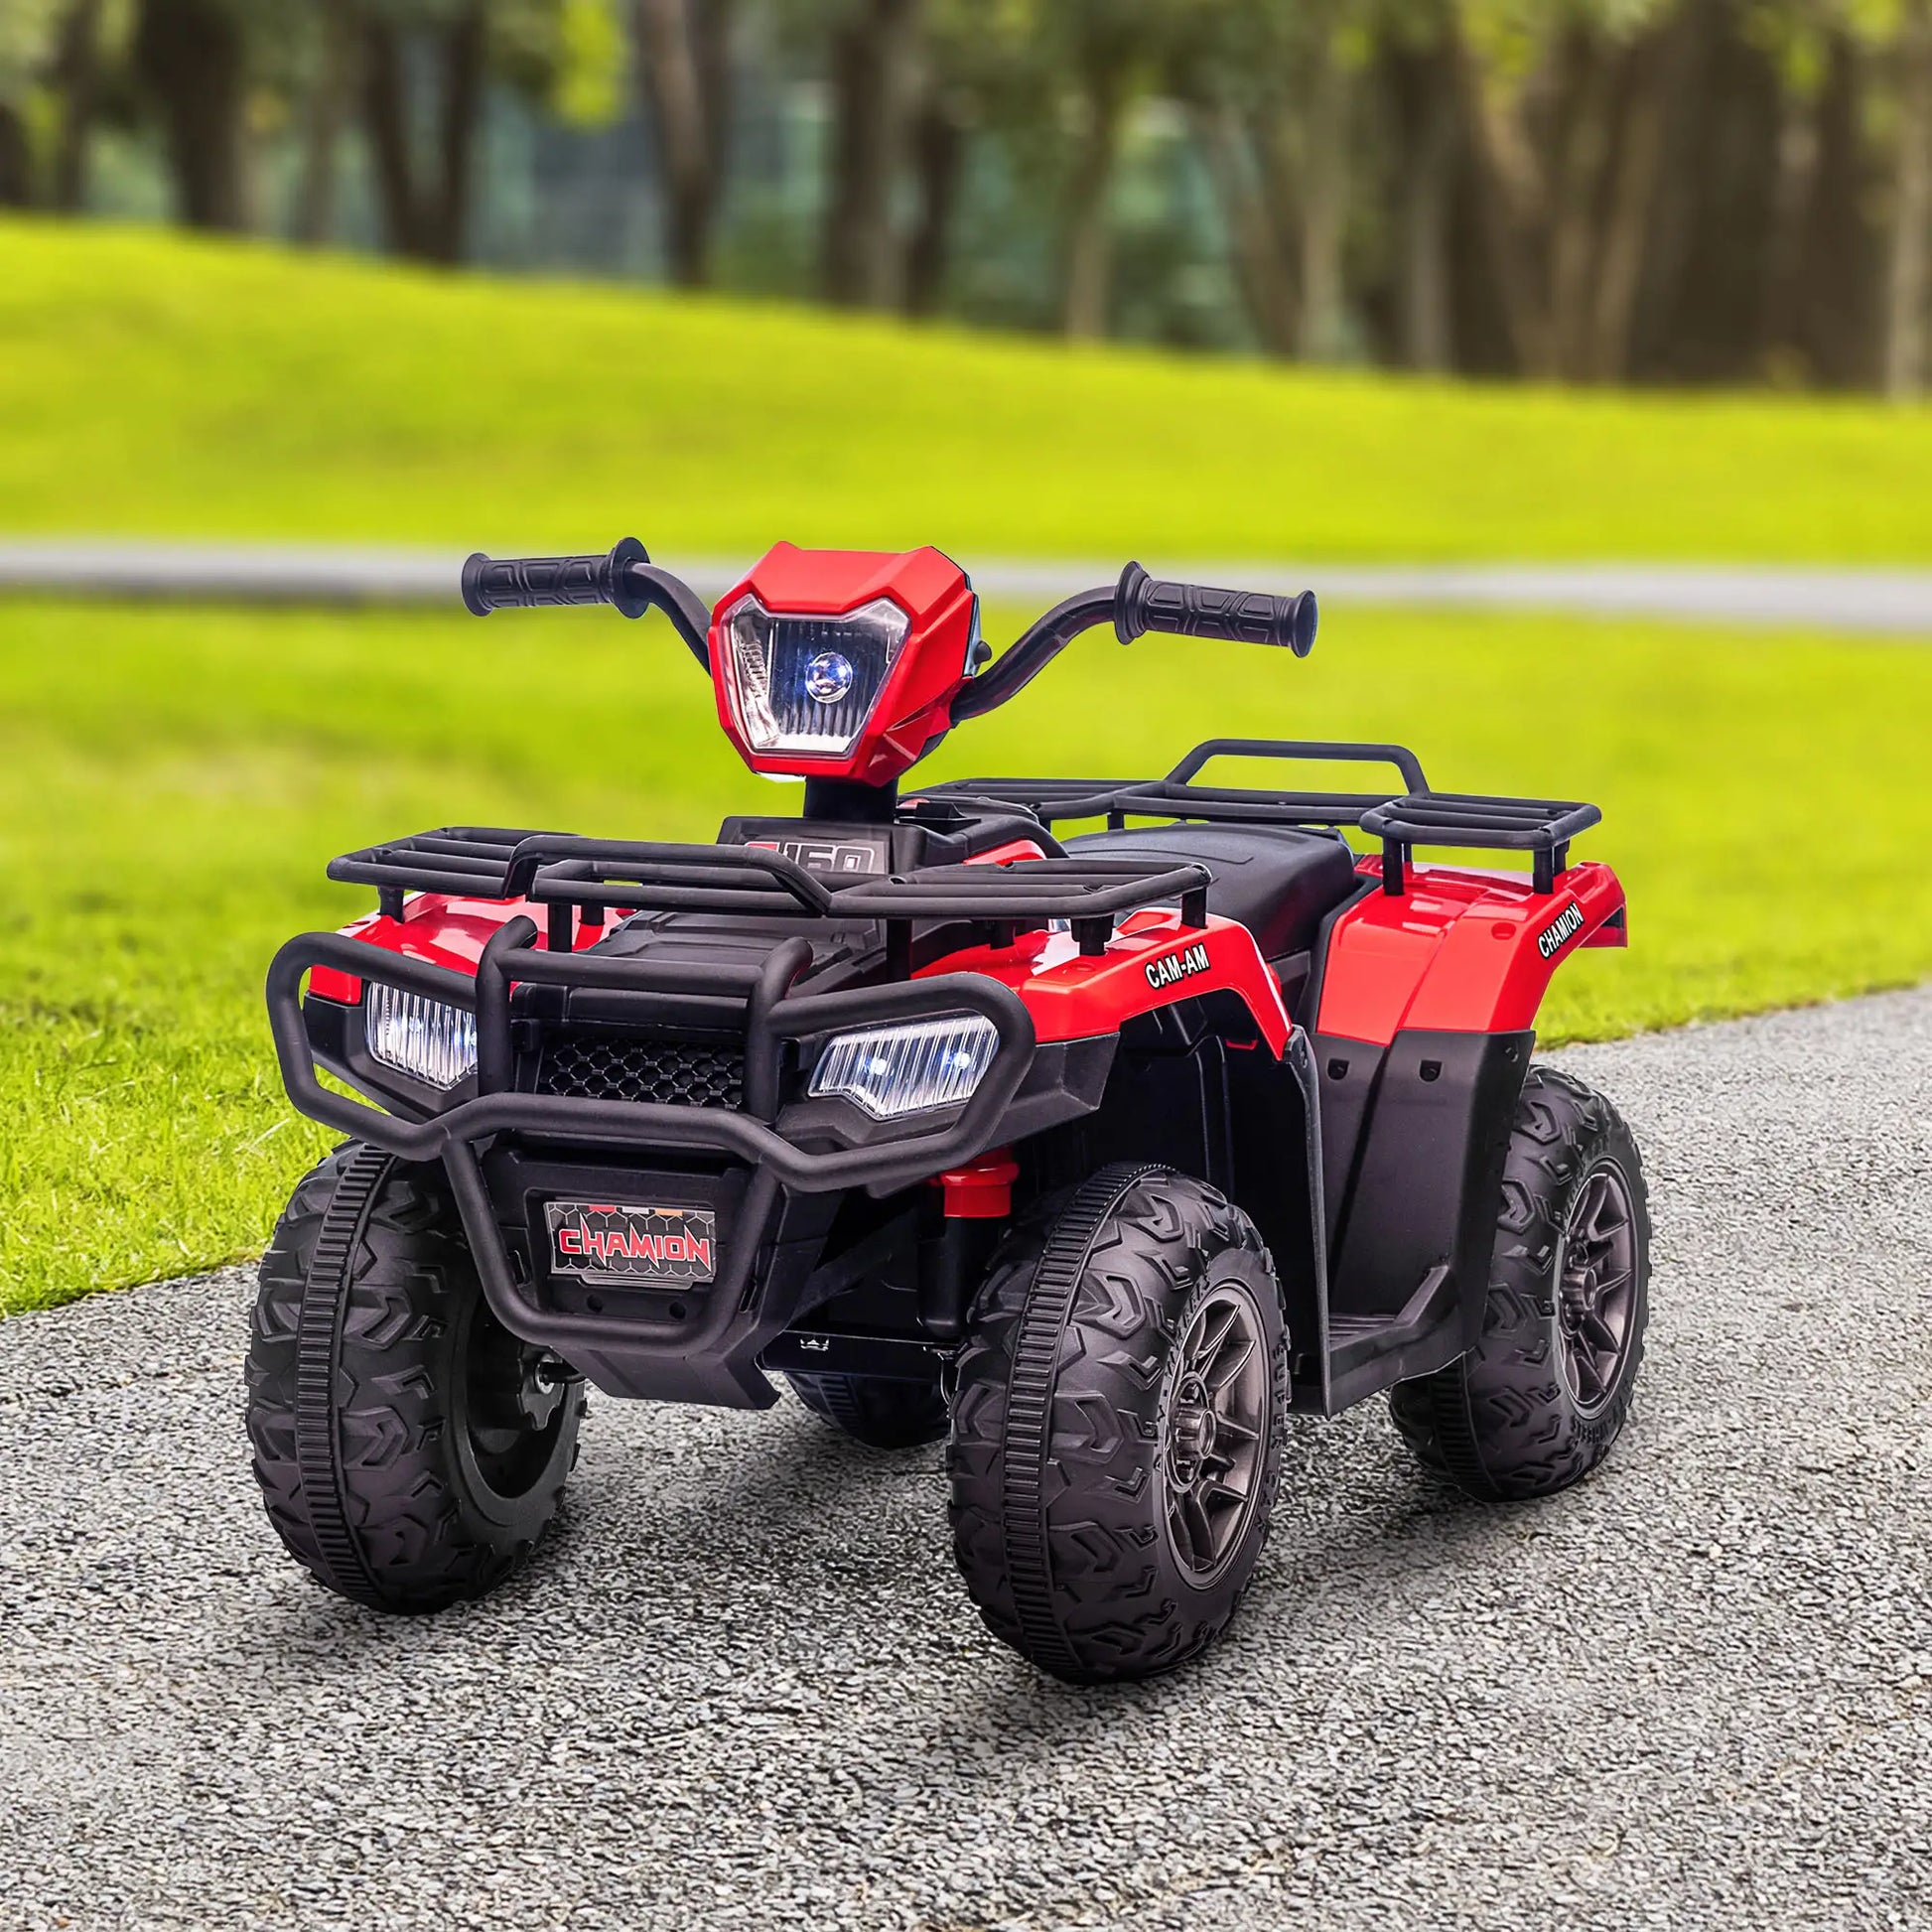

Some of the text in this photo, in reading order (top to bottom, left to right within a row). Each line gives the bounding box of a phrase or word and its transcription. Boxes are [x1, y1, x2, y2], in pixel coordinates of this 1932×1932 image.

[1538, 901, 1585, 958] CHAMION
[1145, 942, 1210, 989] CAM-AM
[558, 1212, 712, 1272] CHAMION
[1272, 1343, 1288, 1450] SUPER
